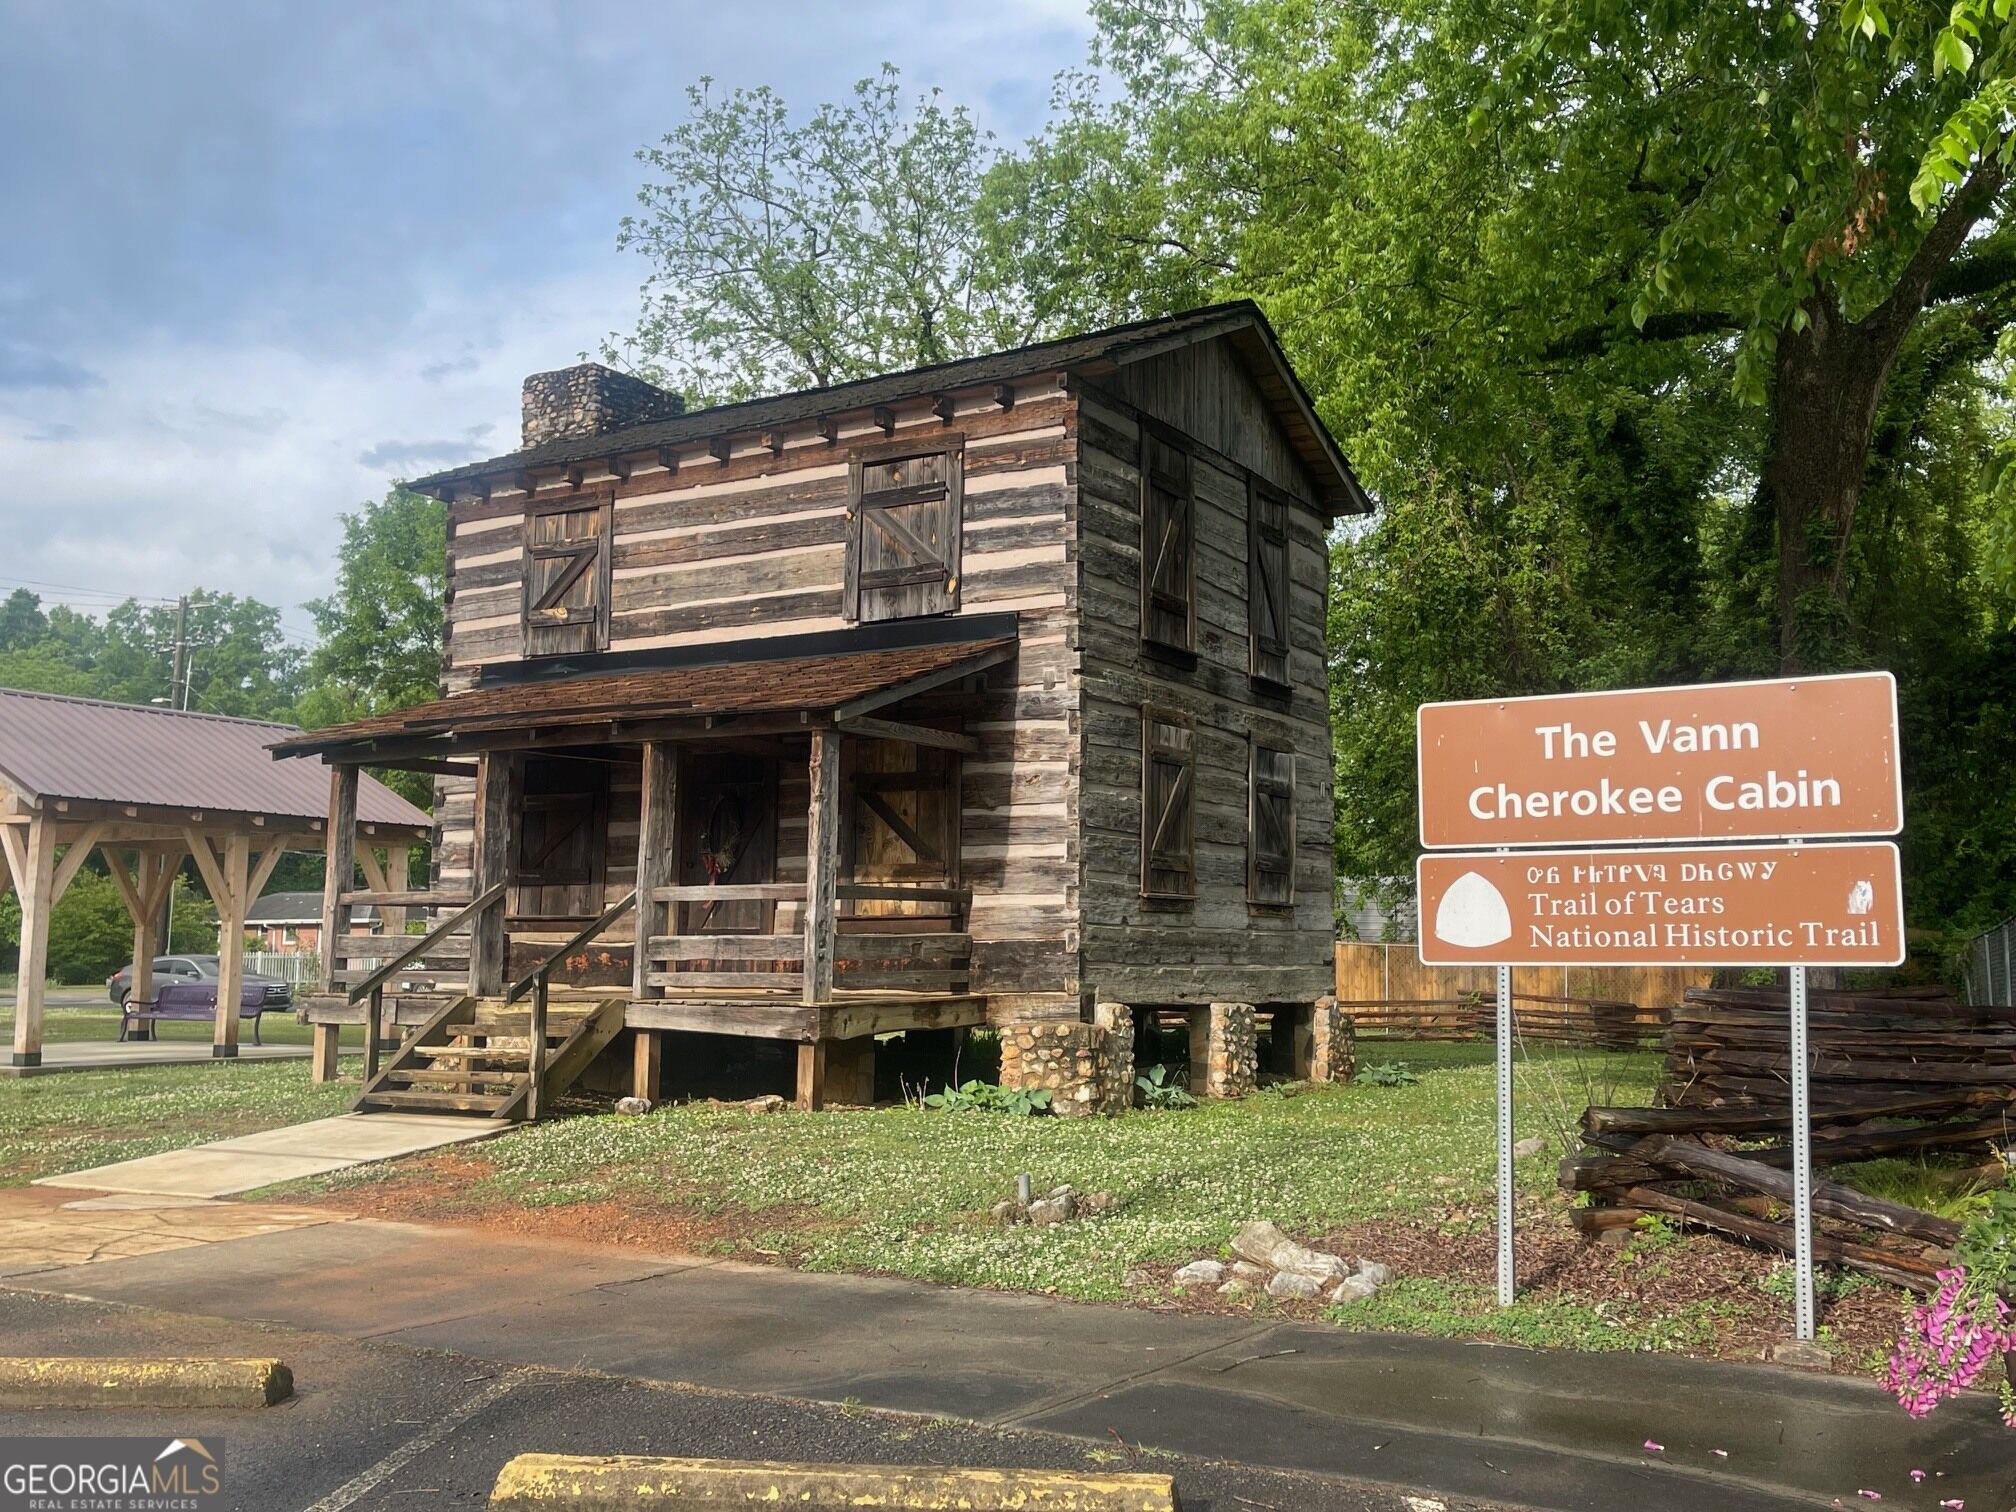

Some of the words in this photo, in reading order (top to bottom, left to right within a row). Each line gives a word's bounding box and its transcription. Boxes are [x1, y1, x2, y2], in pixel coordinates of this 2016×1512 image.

[1535, 723, 1616, 759] The
[1639, 719, 1760, 753] Vann
[1468, 778, 1683, 820] Cherokee
[1705, 770, 1841, 811] Cabin
[1528, 892, 1598, 916] Trail
[1605, 891, 1636, 915] of
[1640, 892, 1725, 914] Tears
[1530, 924, 1658, 948] National
[1665, 923, 1793, 947] Historic
[1800, 921, 1880, 947] Trail
